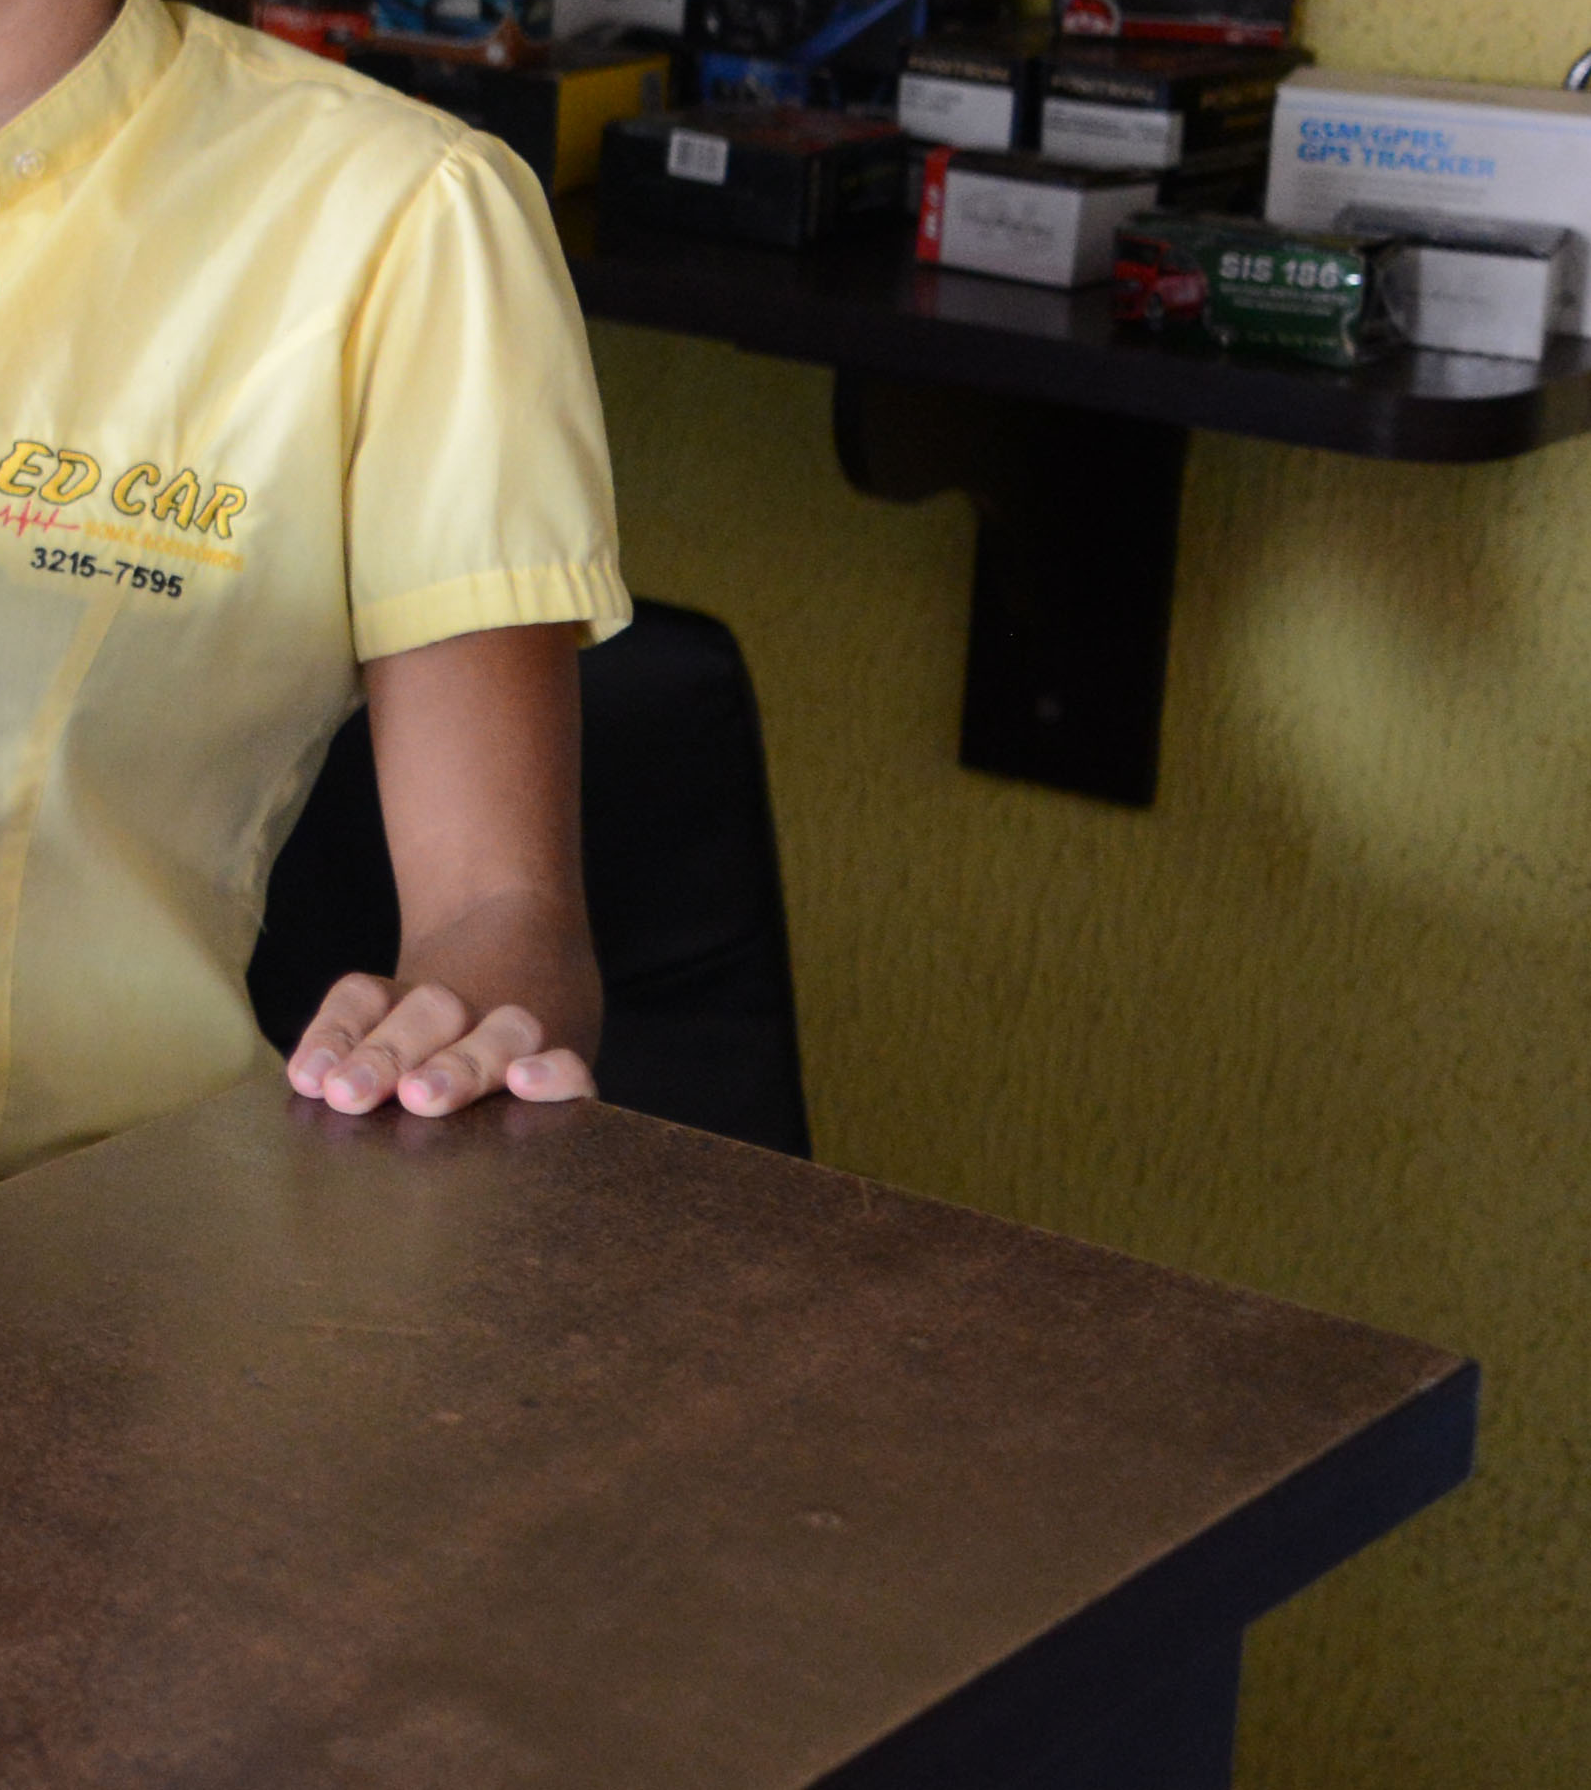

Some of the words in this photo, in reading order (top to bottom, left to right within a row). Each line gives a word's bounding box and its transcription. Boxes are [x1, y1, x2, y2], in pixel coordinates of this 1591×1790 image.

[1297, 142, 1350, 164] GPS
[1362, 148, 1497, 179] TRACKER
[112, 462, 248, 540] CAR
[31, 546, 185, 599] 3215-7595
